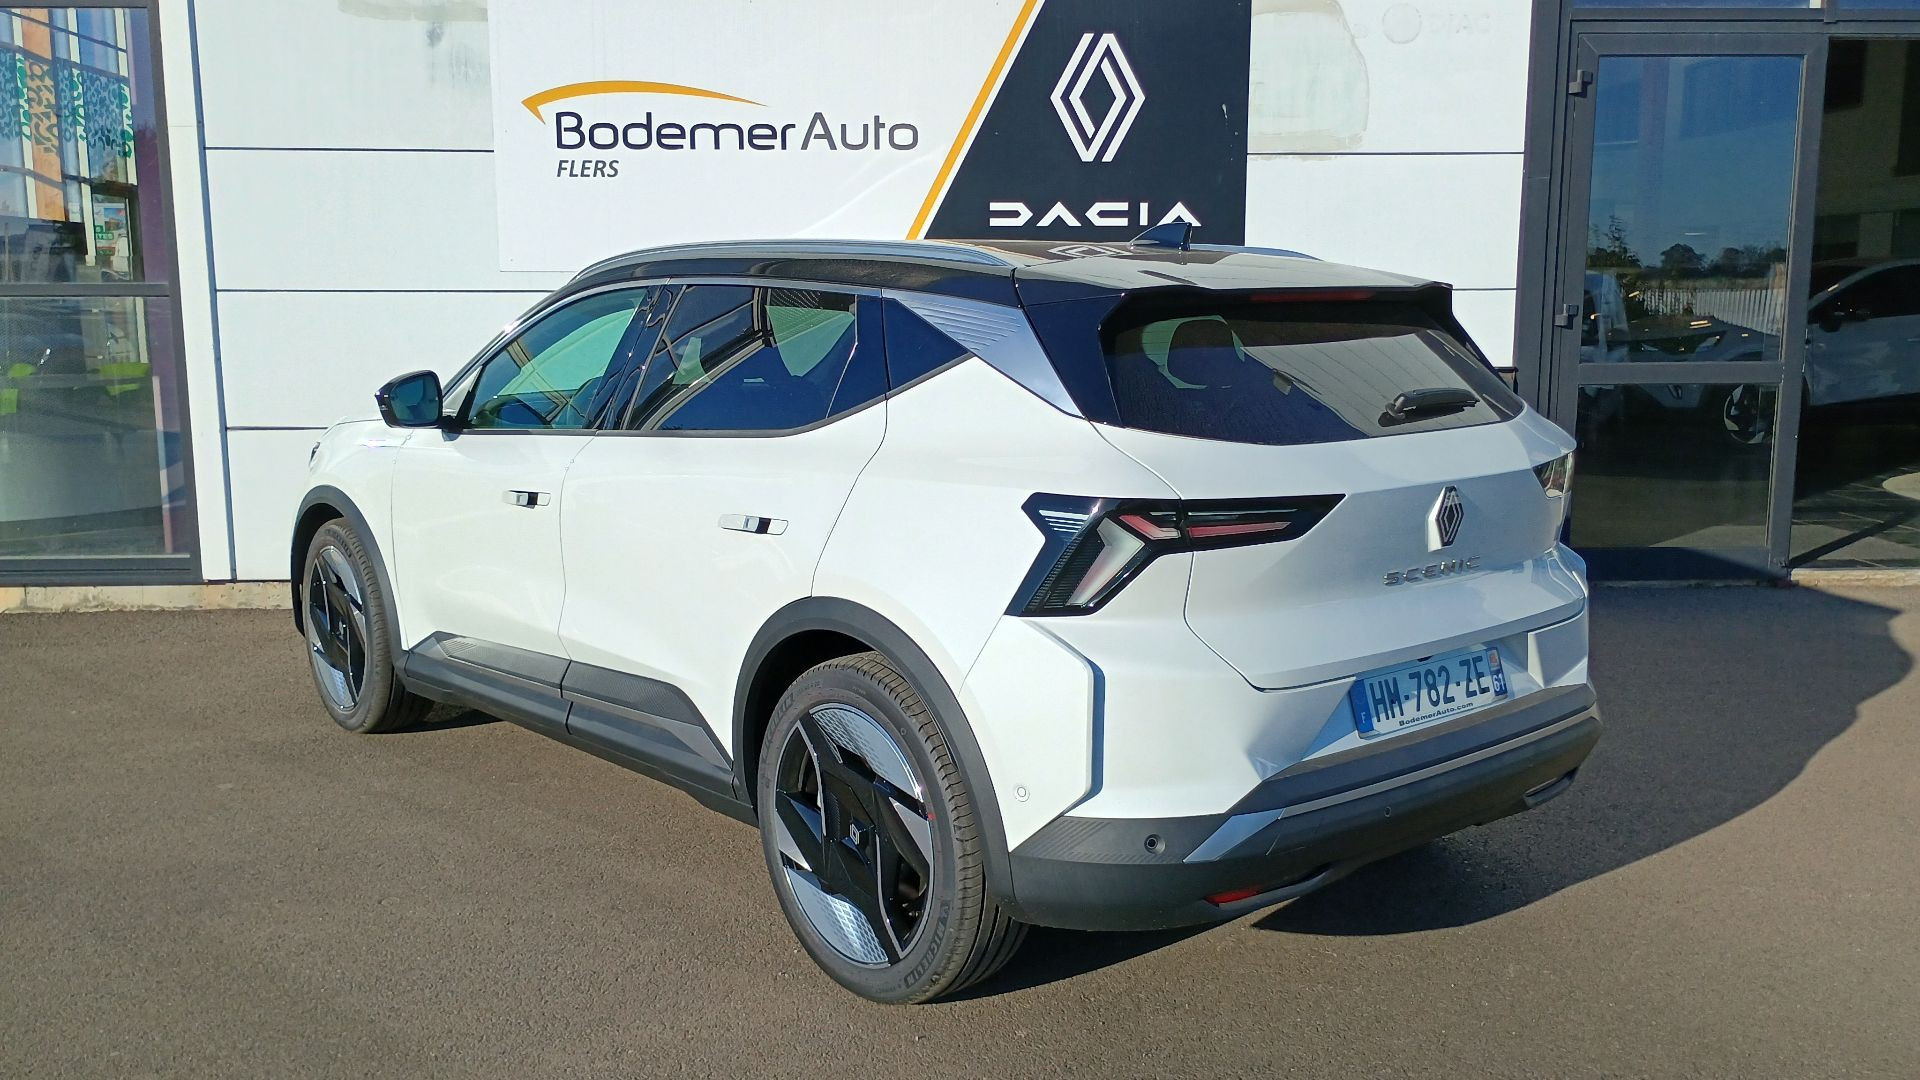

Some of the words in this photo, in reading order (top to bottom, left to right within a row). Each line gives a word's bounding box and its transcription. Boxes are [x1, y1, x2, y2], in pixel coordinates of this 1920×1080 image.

[556, 159, 620, 178] FLERS
[989, 201, 1202, 227] DACIA
[1383, 555, 1480, 586] SCENIC
[1369, 655, 1490, 723] HM-782-ZE
[1492, 673, 1506, 692] 61
[1398, 701, 1473, 726] BodemerAuto.com
[904, 916, 948, 989] MICHELIN
